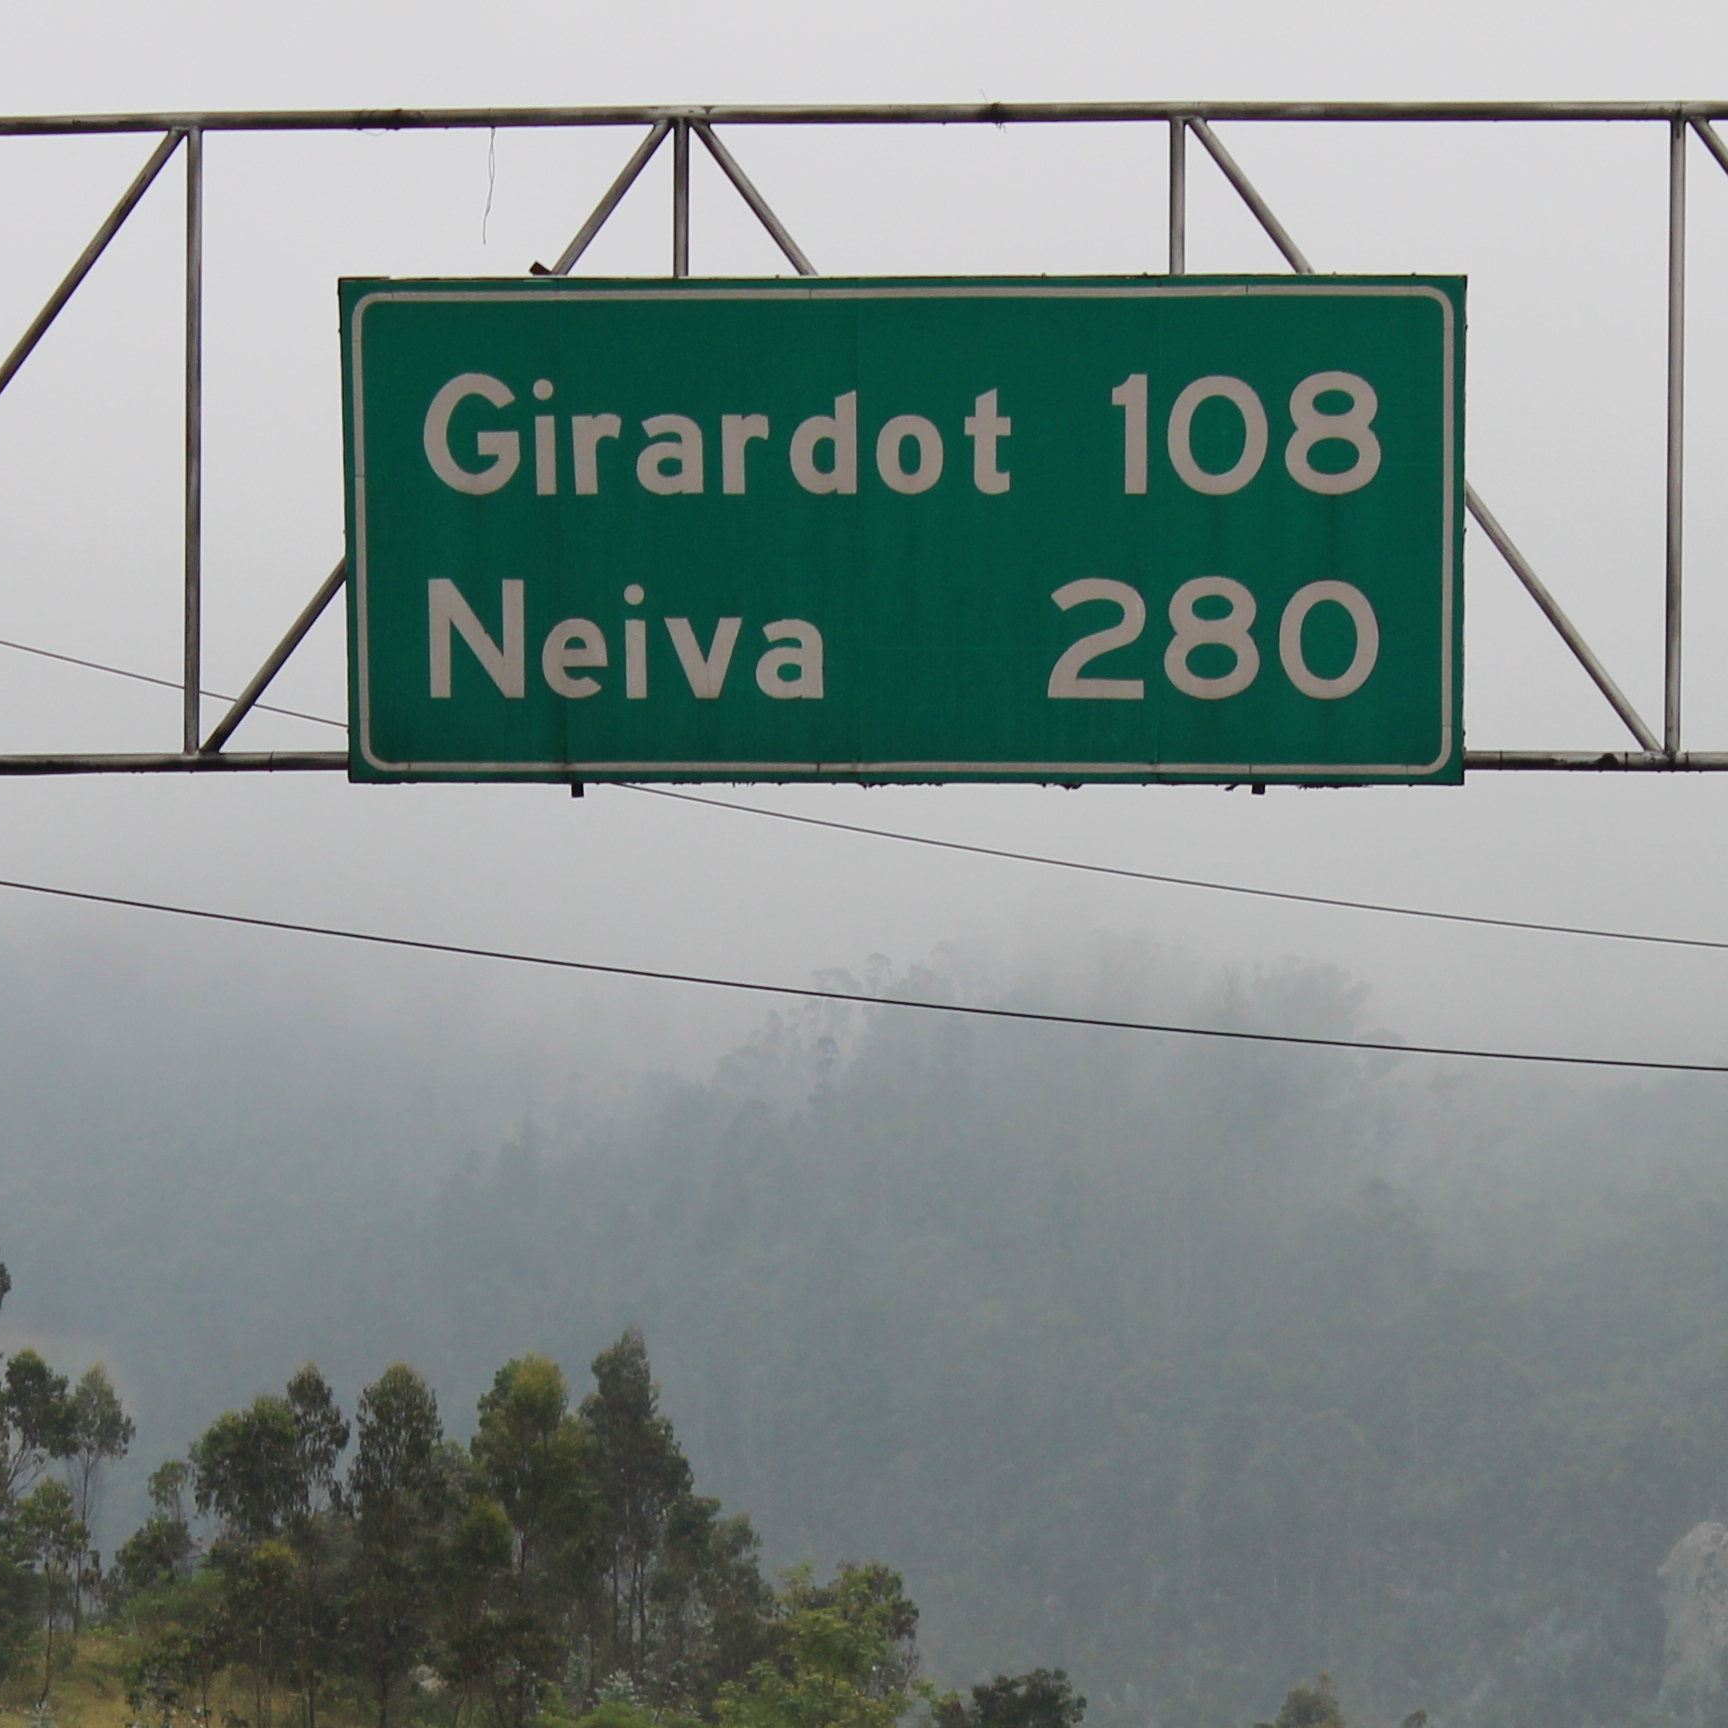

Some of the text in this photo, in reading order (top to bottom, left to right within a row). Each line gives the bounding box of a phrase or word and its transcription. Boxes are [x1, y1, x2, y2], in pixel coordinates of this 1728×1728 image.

[424, 372, 1380, 494] Girardot 108
[429, 577, 1378, 698] Neiva 280
